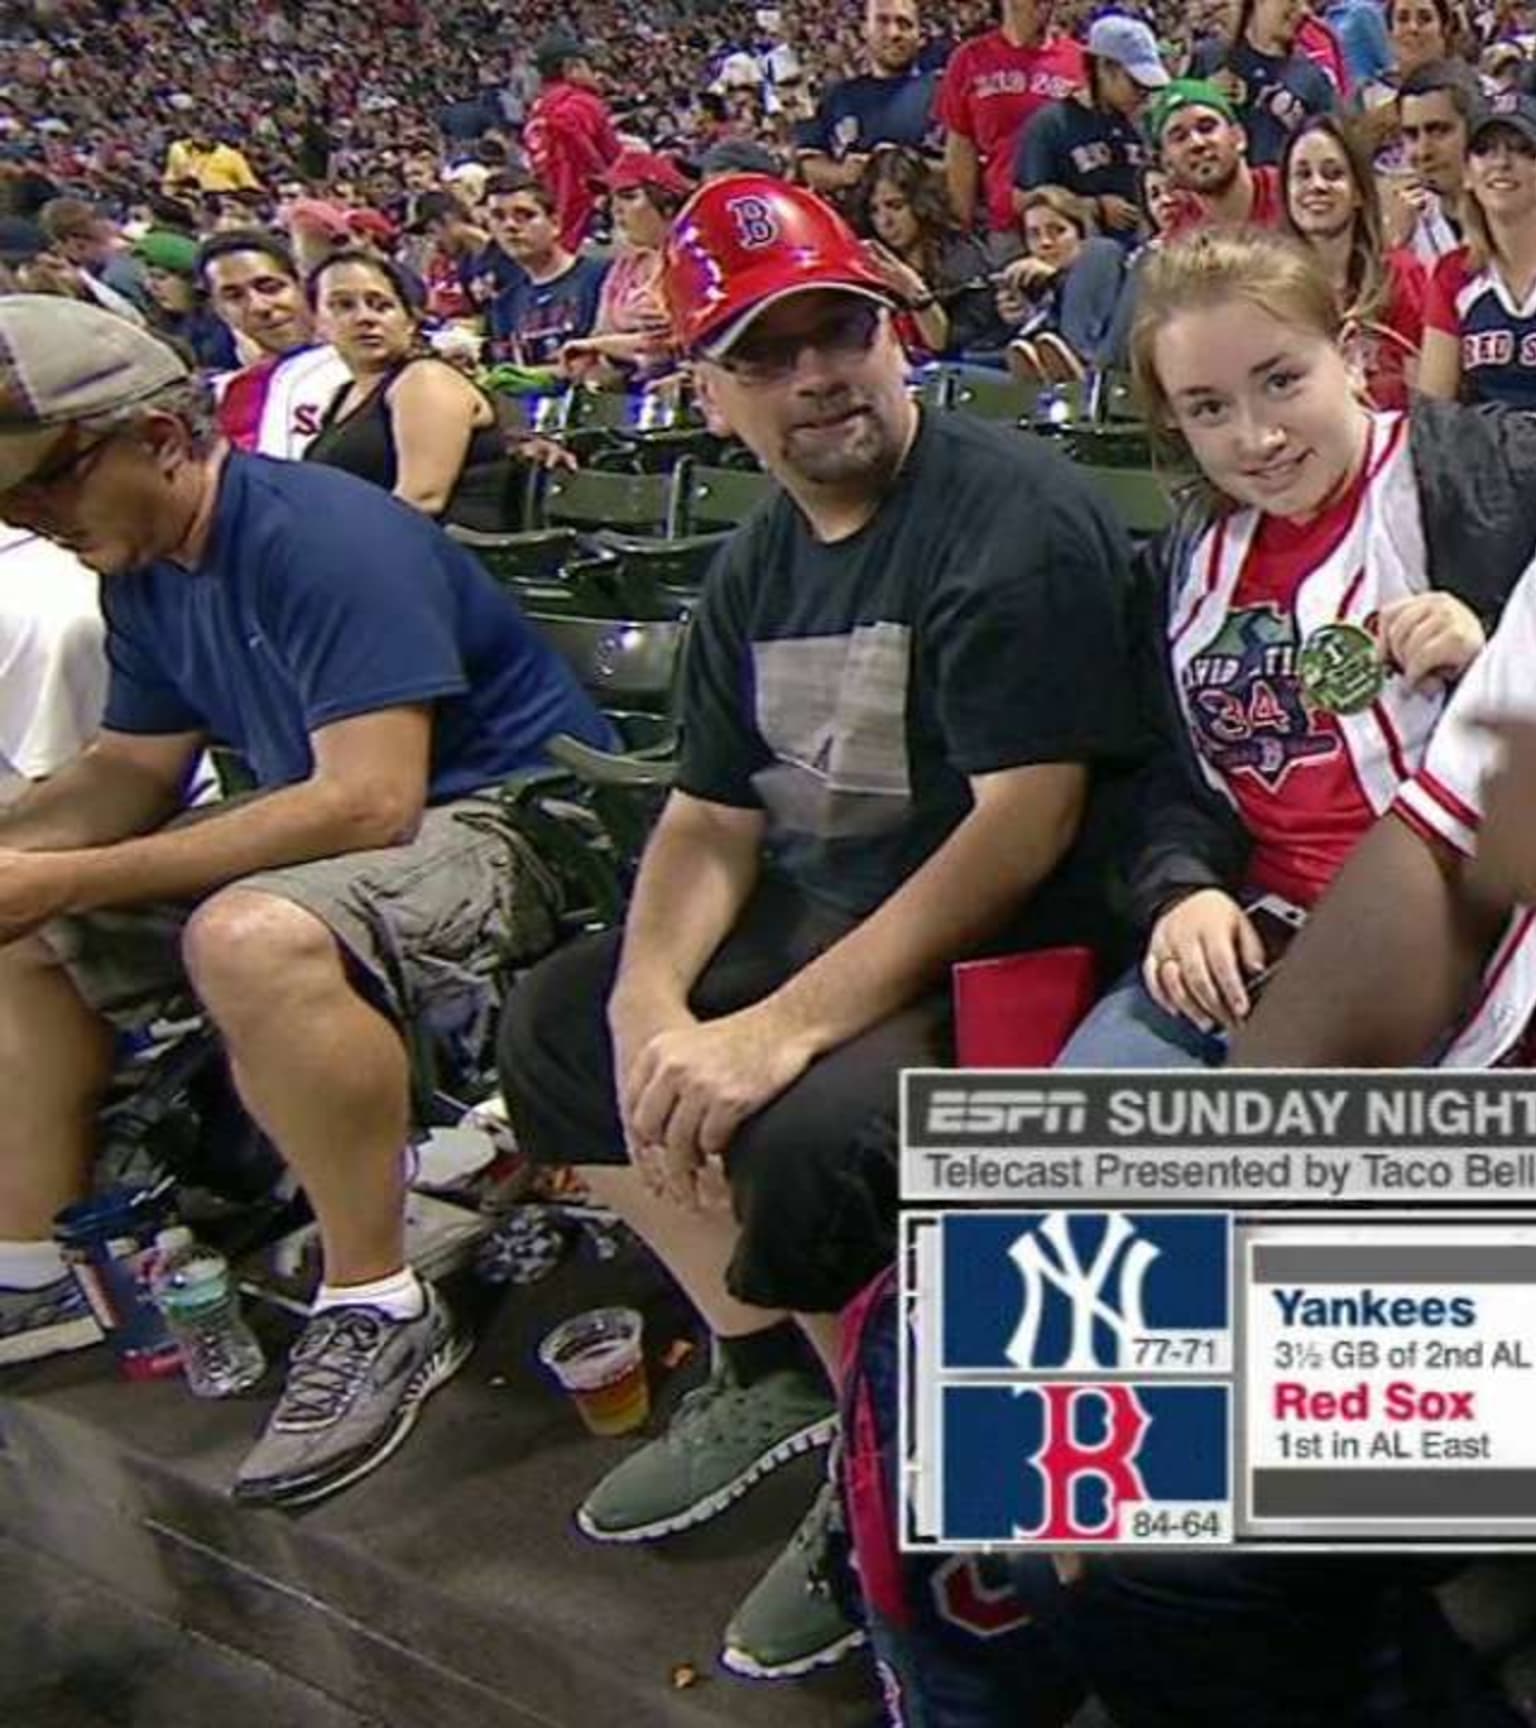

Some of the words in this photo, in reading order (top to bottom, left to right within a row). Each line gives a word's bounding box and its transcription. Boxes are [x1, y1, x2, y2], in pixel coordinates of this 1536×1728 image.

[728, 195, 779, 251] B
[1462, 329, 1515, 371] RED
[1196, 686, 1292, 740] 34
